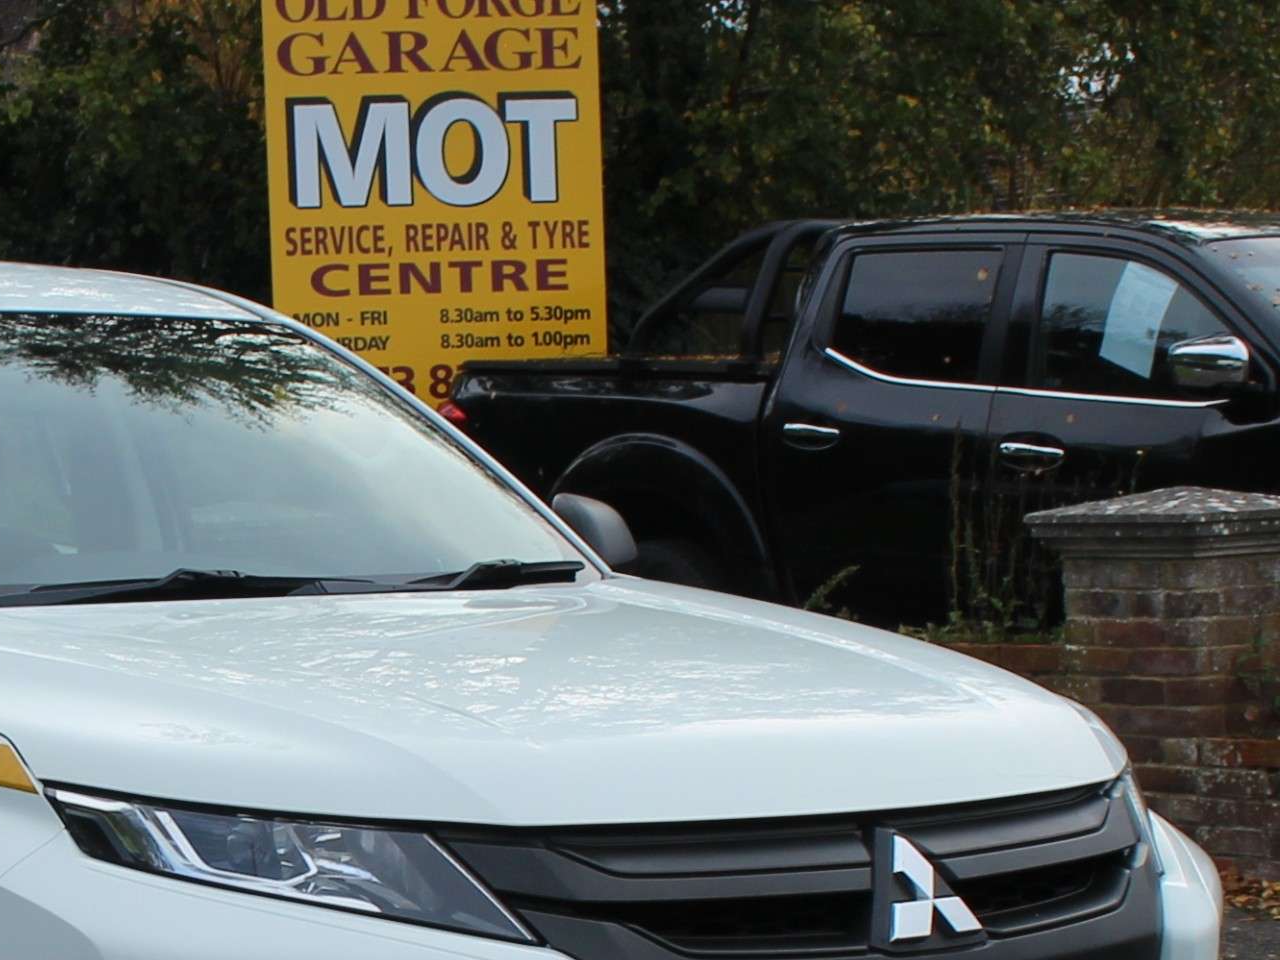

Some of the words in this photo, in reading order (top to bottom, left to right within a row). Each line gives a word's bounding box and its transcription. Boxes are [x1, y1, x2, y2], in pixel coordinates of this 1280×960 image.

[277, 27, 582, 76] GARAGE
[286, 91, 578, 208] MOT
[285, 225, 392, 257] SERVICE,
[405, 222, 489, 252] REPAIR
[501, 221, 517, 250] &
[528, 219, 590, 249] TYRE
[311, 258, 569, 297] CENTRE
[292, 312, 340, 327] MON
[360, 310, 388, 326] FRI
[439, 308, 500, 323] 8.30am
[506, 307, 524, 322] to
[530, 305, 591, 324] 5.30pm
[440, 333, 501, 349] 8.30am
[507, 332, 525, 347] to
[532, 331, 590, 348] 1.00pm
